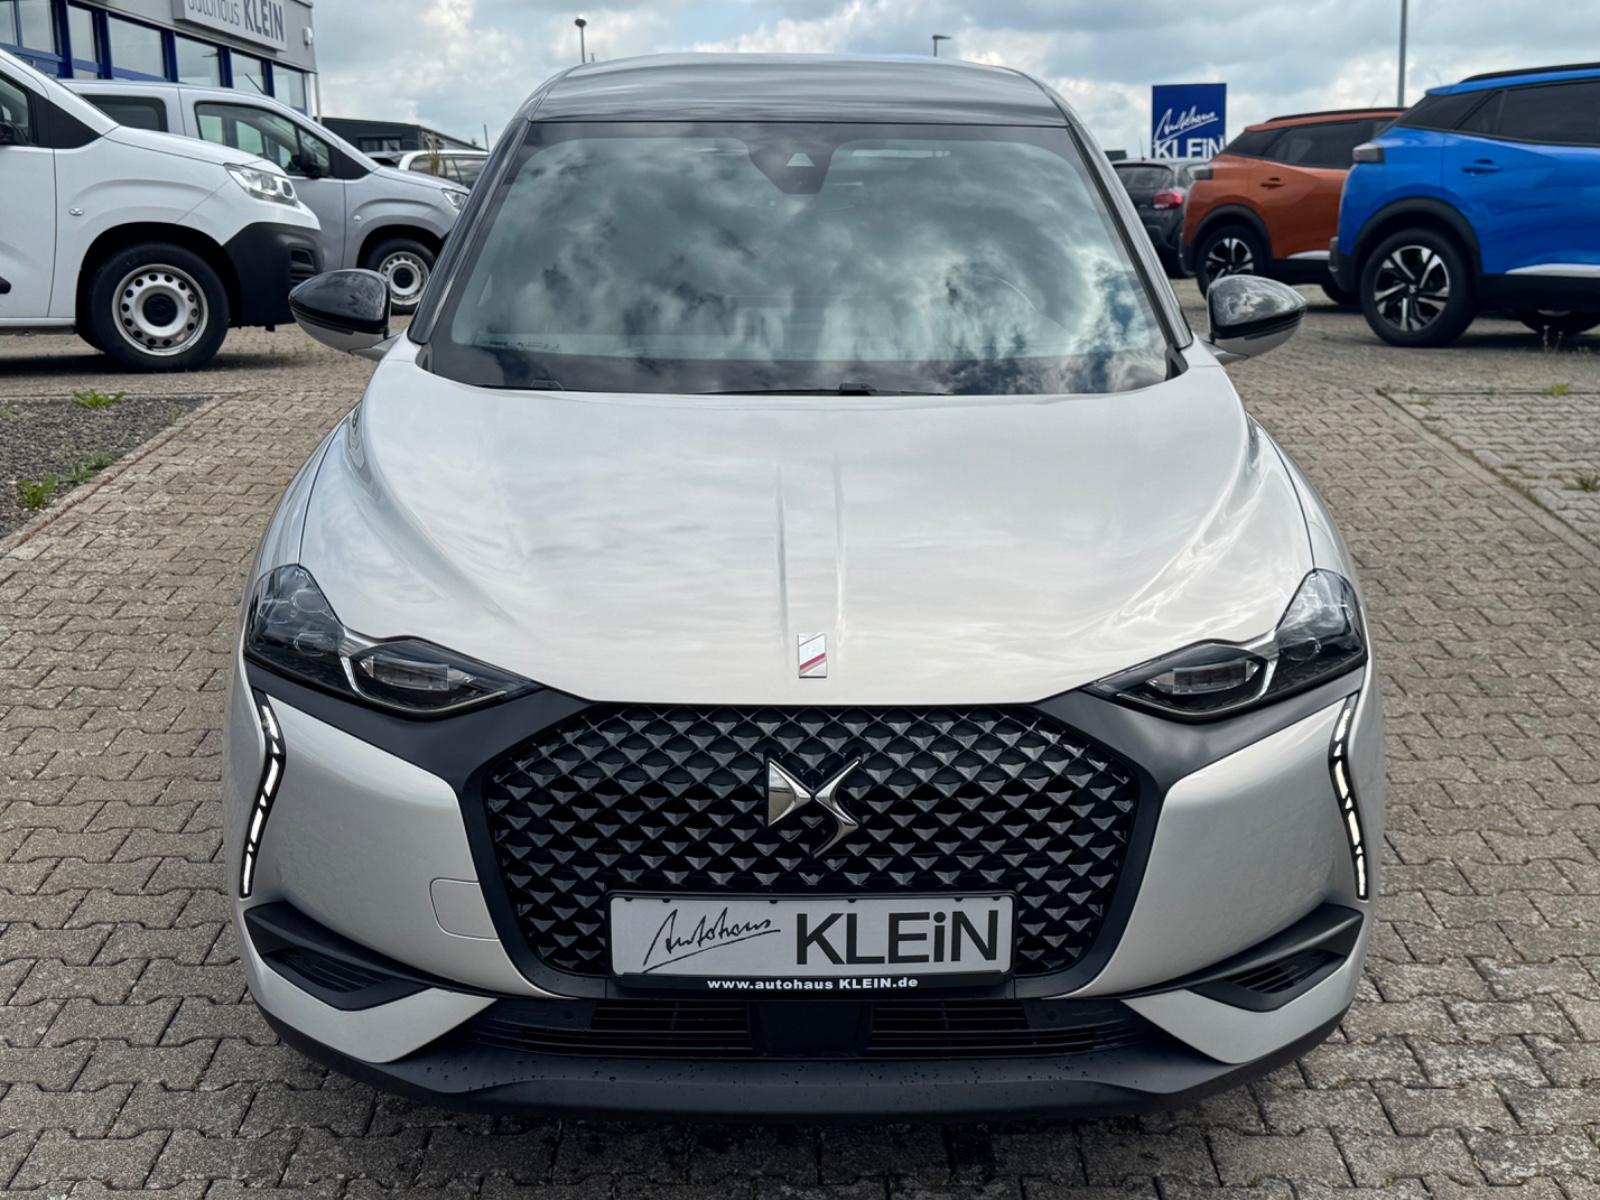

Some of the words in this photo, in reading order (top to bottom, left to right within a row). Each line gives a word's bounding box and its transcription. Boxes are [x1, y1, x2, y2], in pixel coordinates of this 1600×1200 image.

[243, 0, 285, 42] KLEIN
[706, 978, 834, 990] www.autohaus
[838, 976, 919, 989] KLEIN.de
